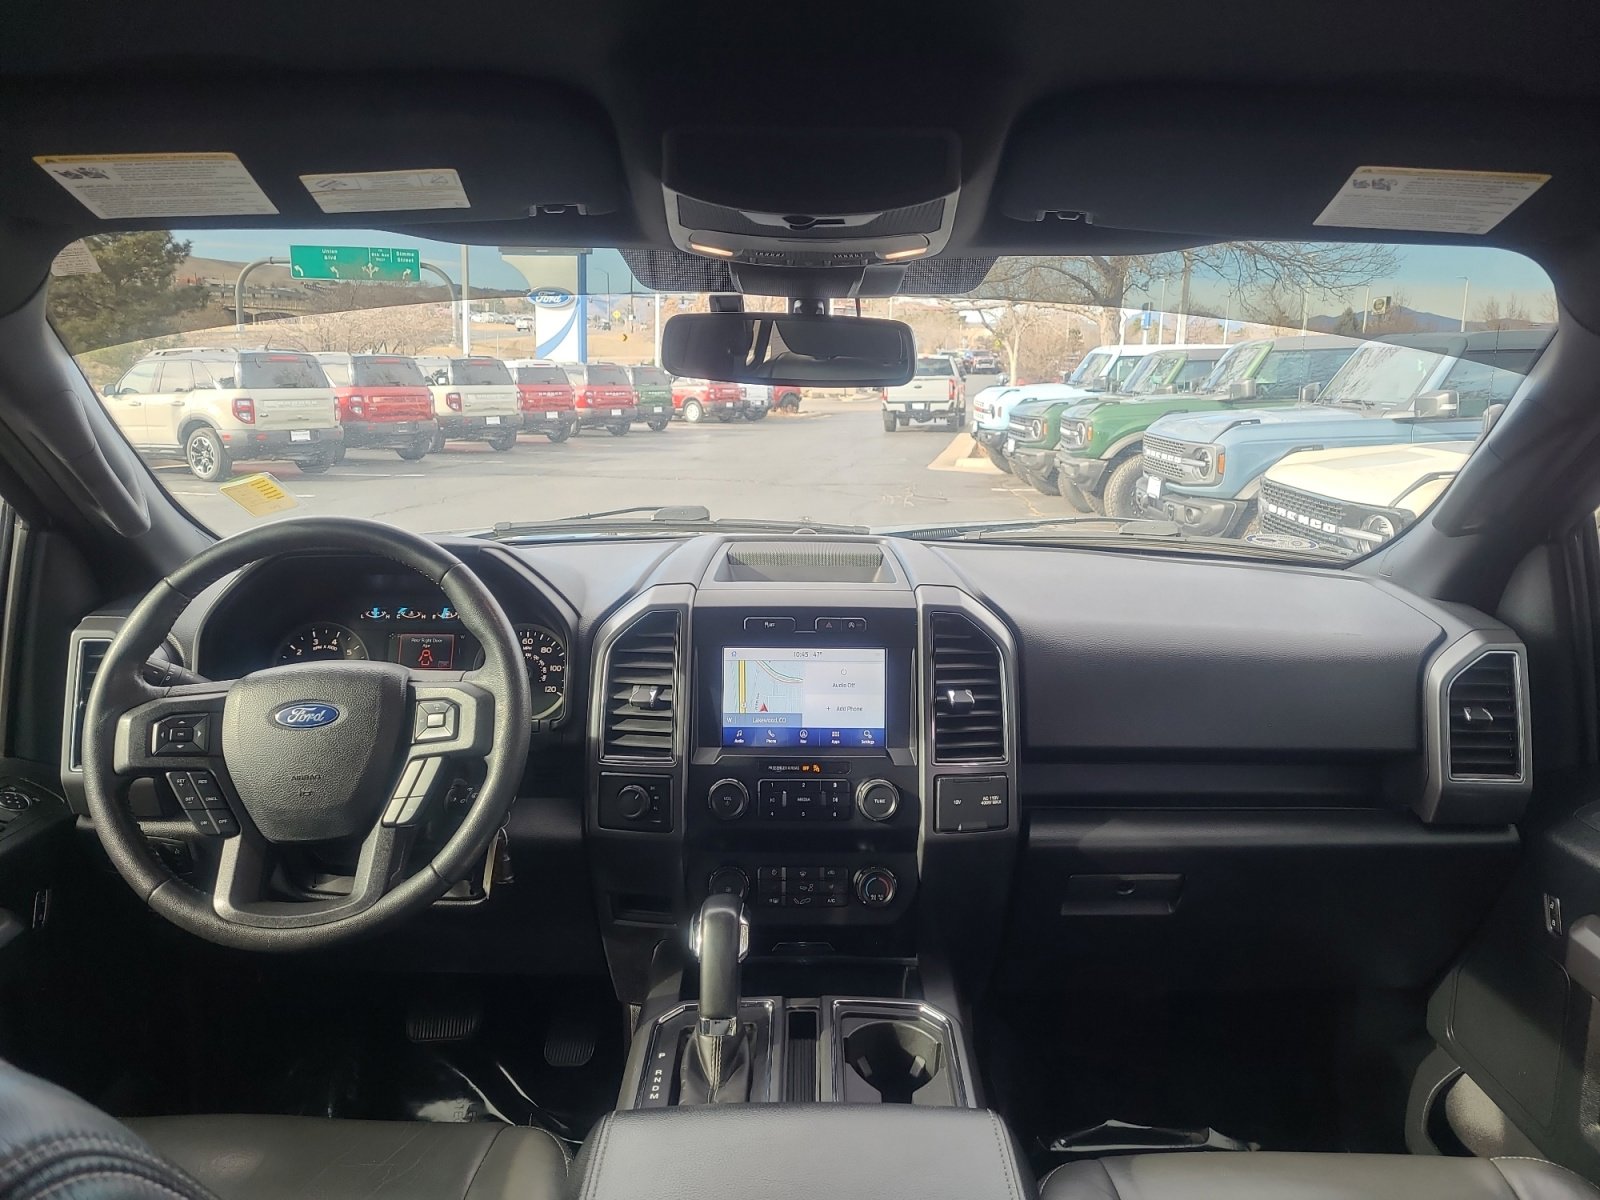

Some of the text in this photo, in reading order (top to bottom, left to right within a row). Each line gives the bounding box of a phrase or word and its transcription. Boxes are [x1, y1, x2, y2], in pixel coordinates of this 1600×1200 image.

[535, 292, 563, 303] Ford
[1268, 503, 1336, 534] BRONCO
[287, 707, 327, 722] Ford
